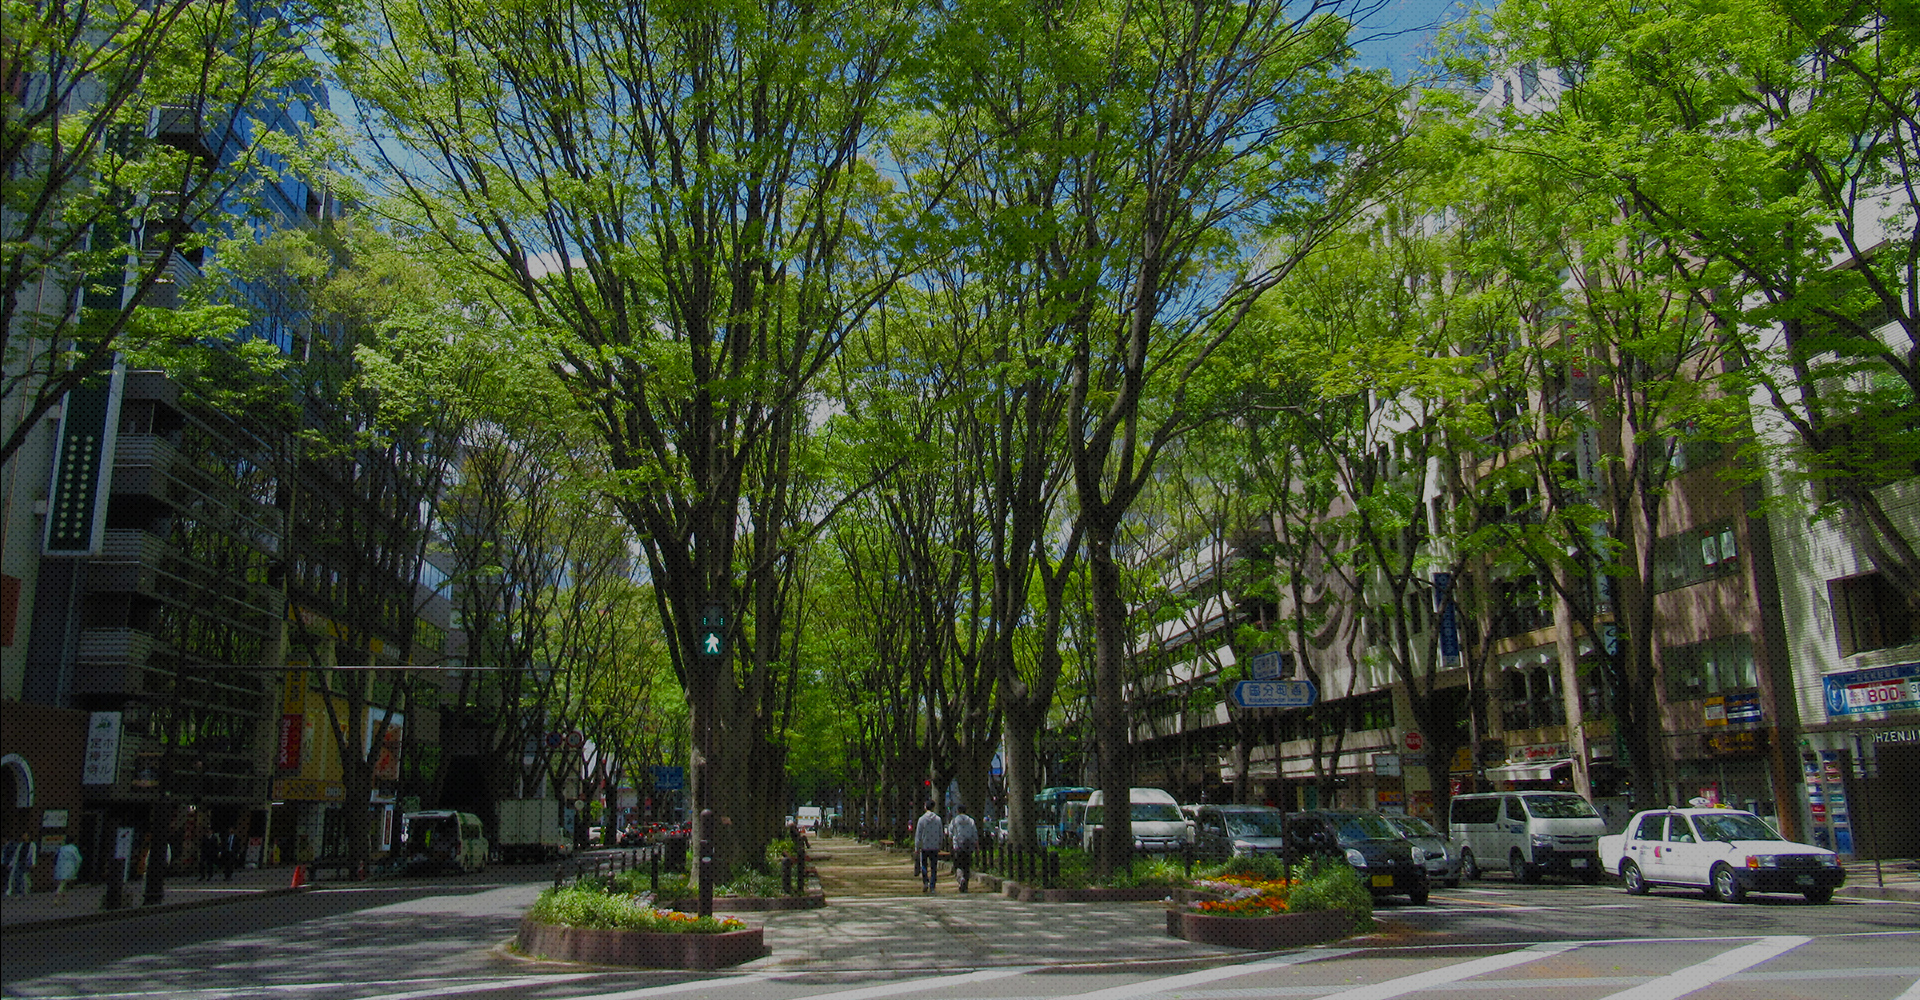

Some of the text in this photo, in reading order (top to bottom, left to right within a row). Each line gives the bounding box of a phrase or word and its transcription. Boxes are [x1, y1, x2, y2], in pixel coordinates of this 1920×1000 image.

[100, 737, 115, 776] ホテル
[279, 718, 292, 764] SHIDAX
